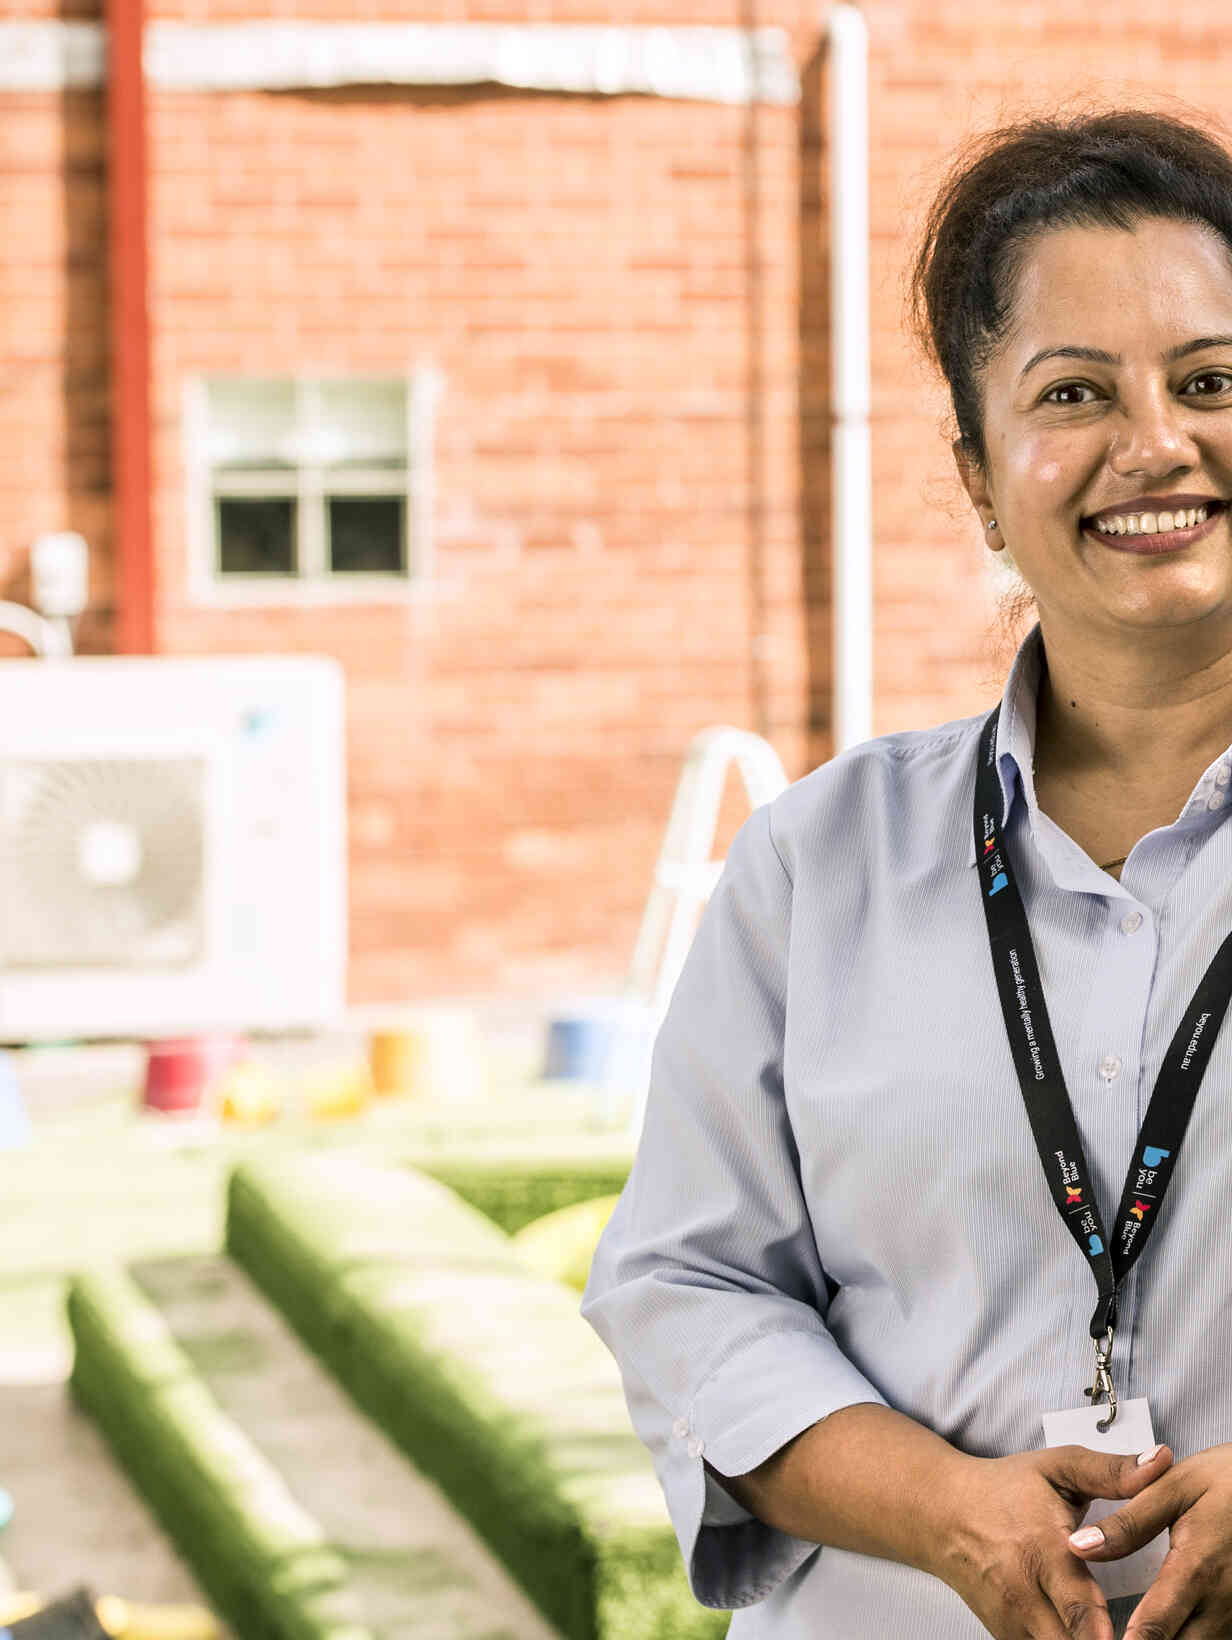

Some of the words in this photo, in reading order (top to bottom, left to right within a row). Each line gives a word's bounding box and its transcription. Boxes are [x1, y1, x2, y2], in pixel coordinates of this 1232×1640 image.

[1009, 948, 1025, 985] generation
[1020, 1010, 1034, 1040] mentally
[1180, 1013, 1212, 1070] beyou.edu.au
[1030, 1045, 1045, 1080] Growing
[1054, 1150, 1071, 1185] Beyond
[1069, 1161, 1080, 1182] Blue
[1136, 1168, 1148, 1189] you
[1146, 1170, 1158, 1185] be
[1080, 1219, 1091, 1234] be
[1084, 1211, 1098, 1231] you
[1121, 1220, 1134, 1241] Blue
[1123, 1221, 1142, 1255] Beyond
